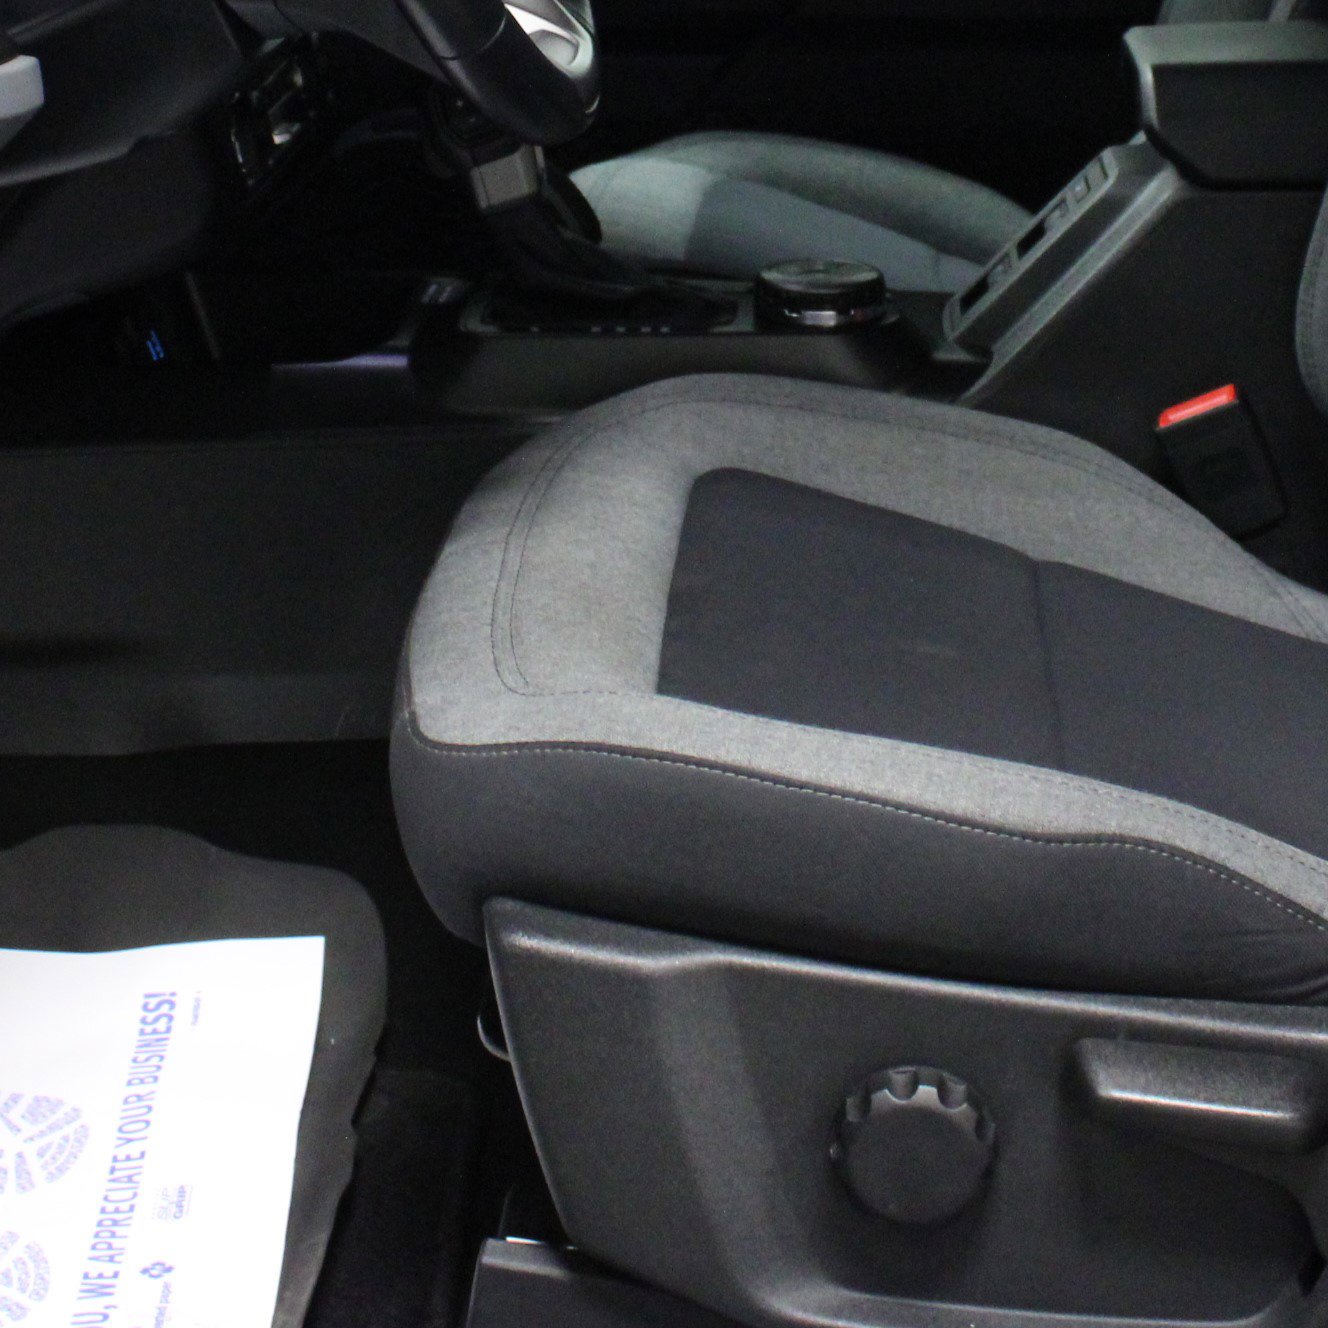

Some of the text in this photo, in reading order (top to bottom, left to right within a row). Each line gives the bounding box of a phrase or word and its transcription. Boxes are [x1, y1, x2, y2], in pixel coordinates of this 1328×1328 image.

[125, 991, 178, 1087] BUSINESS!
[113, 1090, 158, 1149] YOUR
[87, 1149, 147, 1265] APPRECIATE
[76, 1270, 121, 1300] WE
